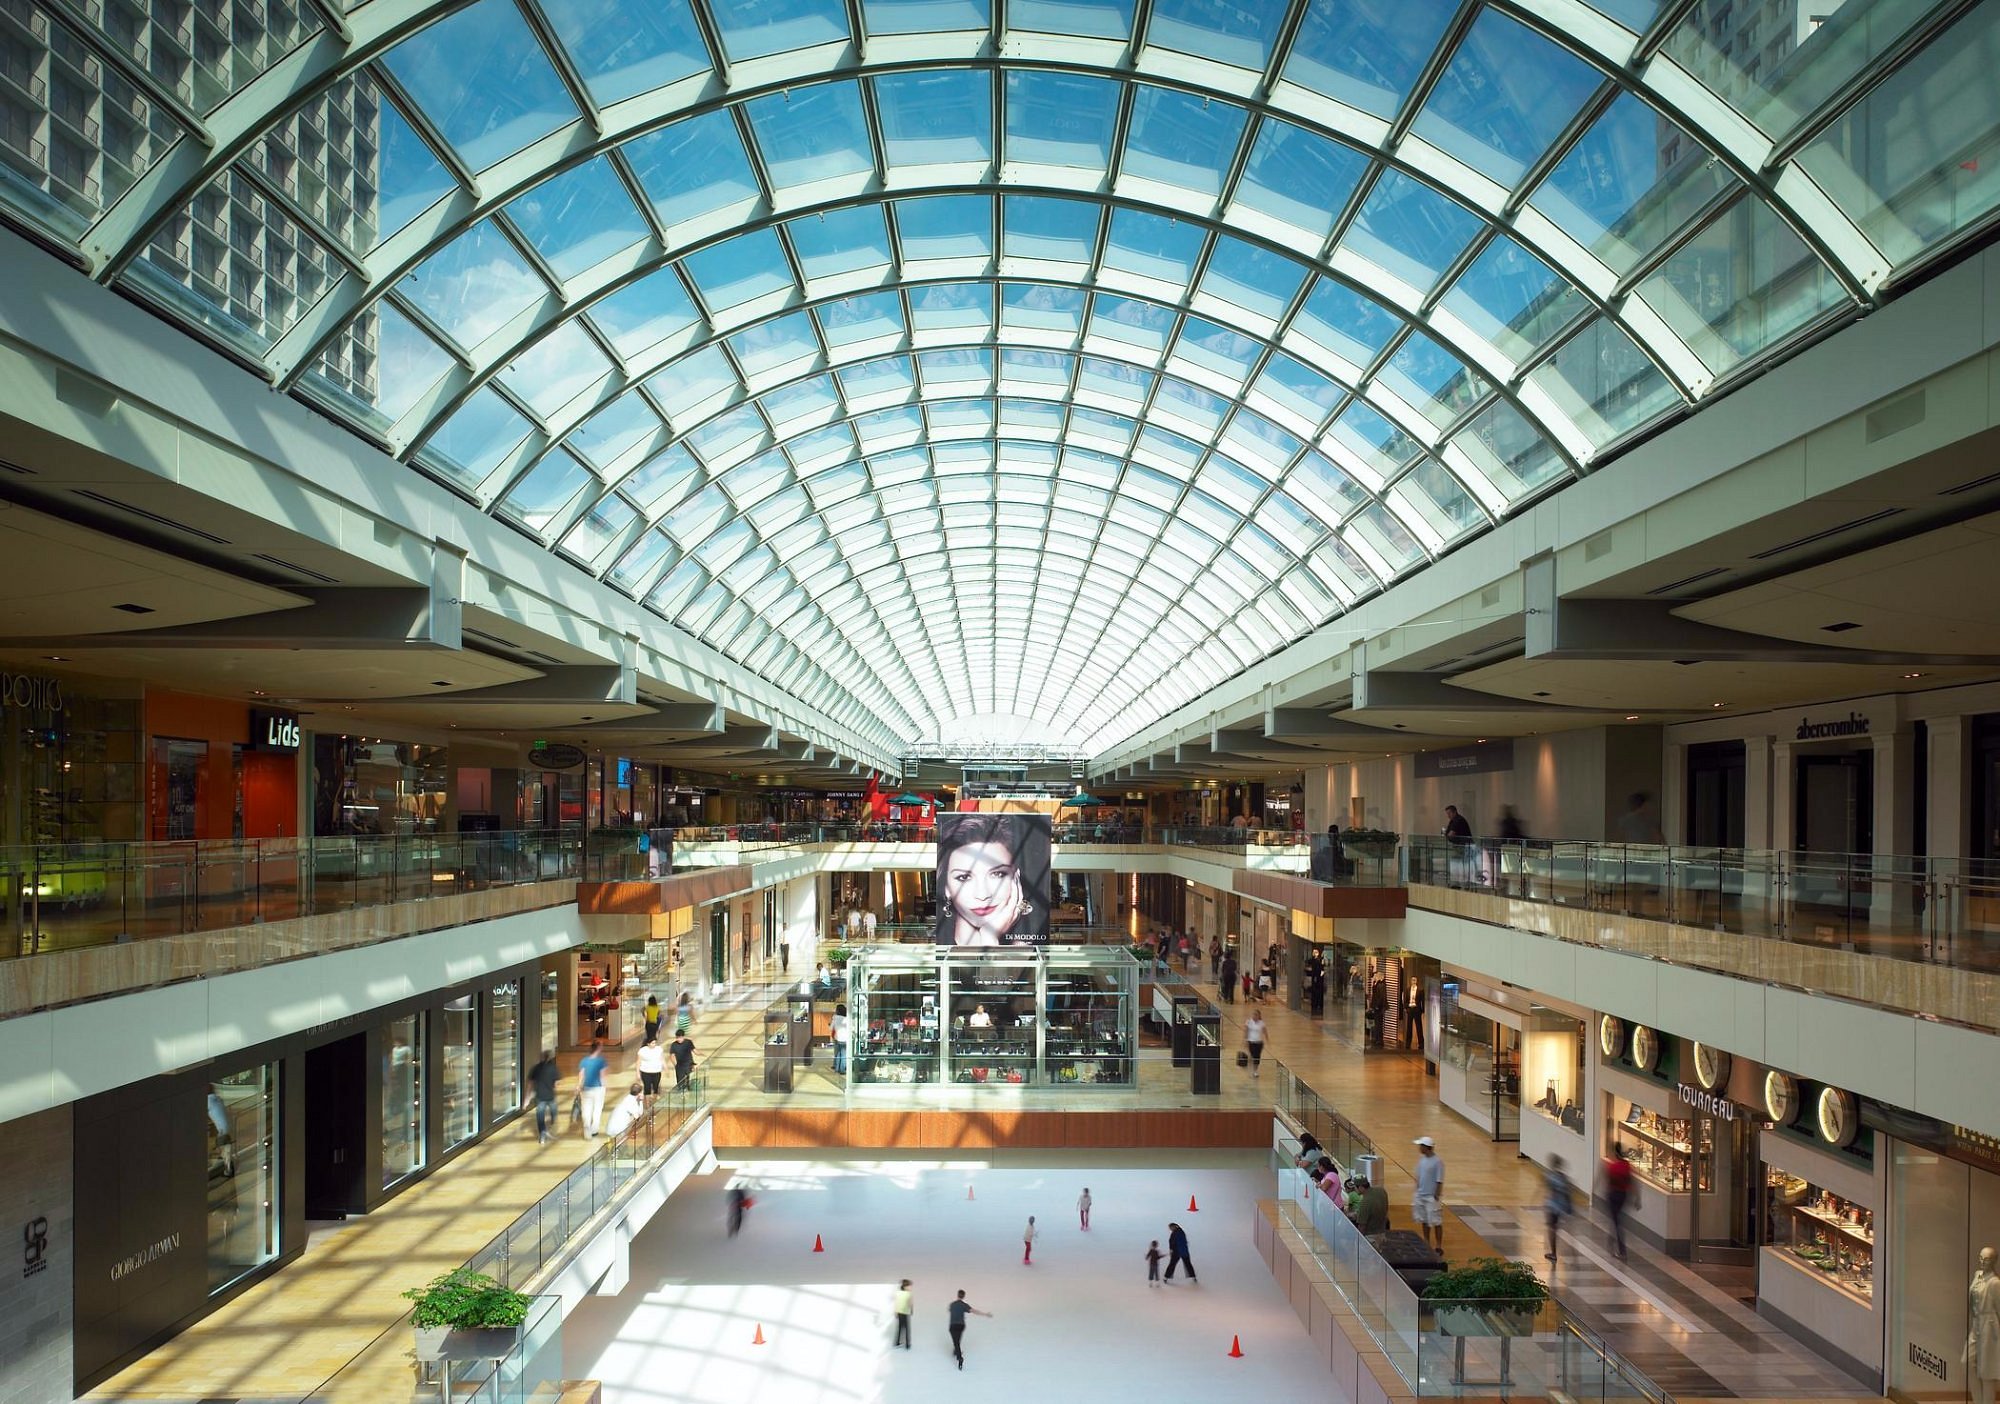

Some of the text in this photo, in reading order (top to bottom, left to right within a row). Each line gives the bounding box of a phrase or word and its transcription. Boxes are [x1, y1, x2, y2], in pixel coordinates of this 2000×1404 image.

[268, 717, 300, 747] Lids
[1796, 711, 1869, 740] abercrombie
[1014, 933, 1047, 941] MODOLO
[1677, 1082, 1733, 1121] TOURNEAU
[110, 1231, 180, 1281] GIORGIO ARMANI
